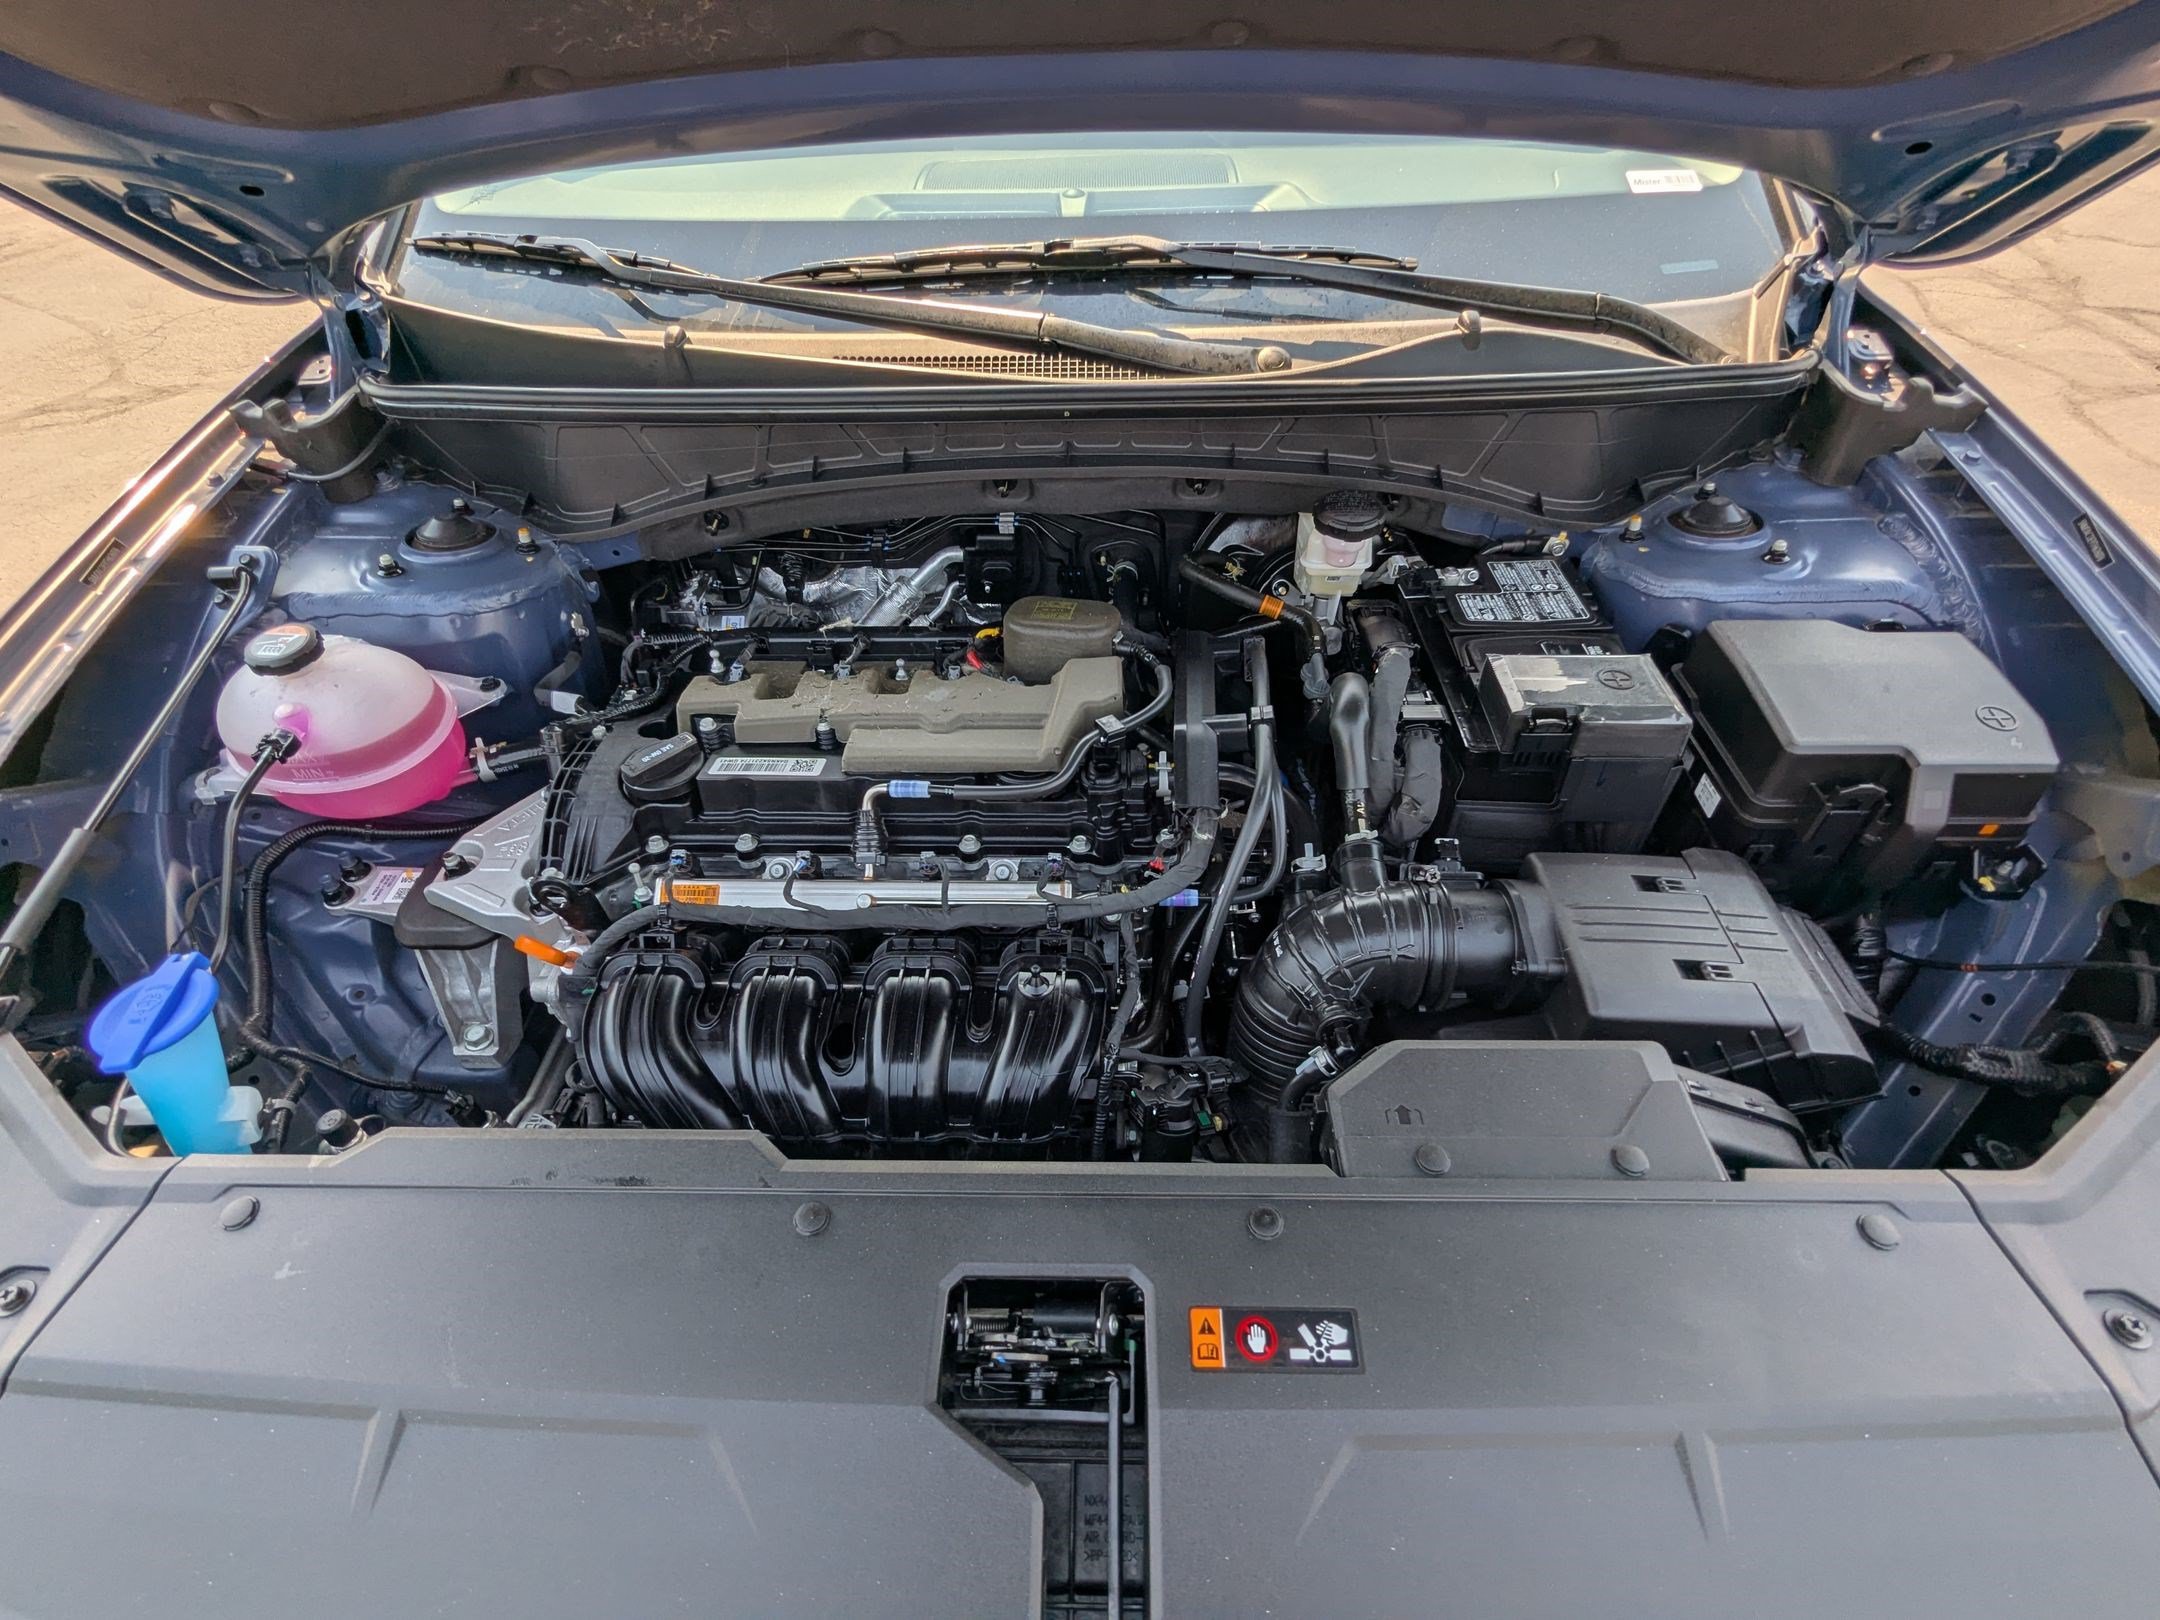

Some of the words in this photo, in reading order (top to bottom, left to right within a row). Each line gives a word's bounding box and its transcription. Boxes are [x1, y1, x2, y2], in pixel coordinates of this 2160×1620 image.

[660, 744, 674, 752] SAE
[641, 749, 662, 763] 0W-20
[291, 768, 325, 779] MIN
